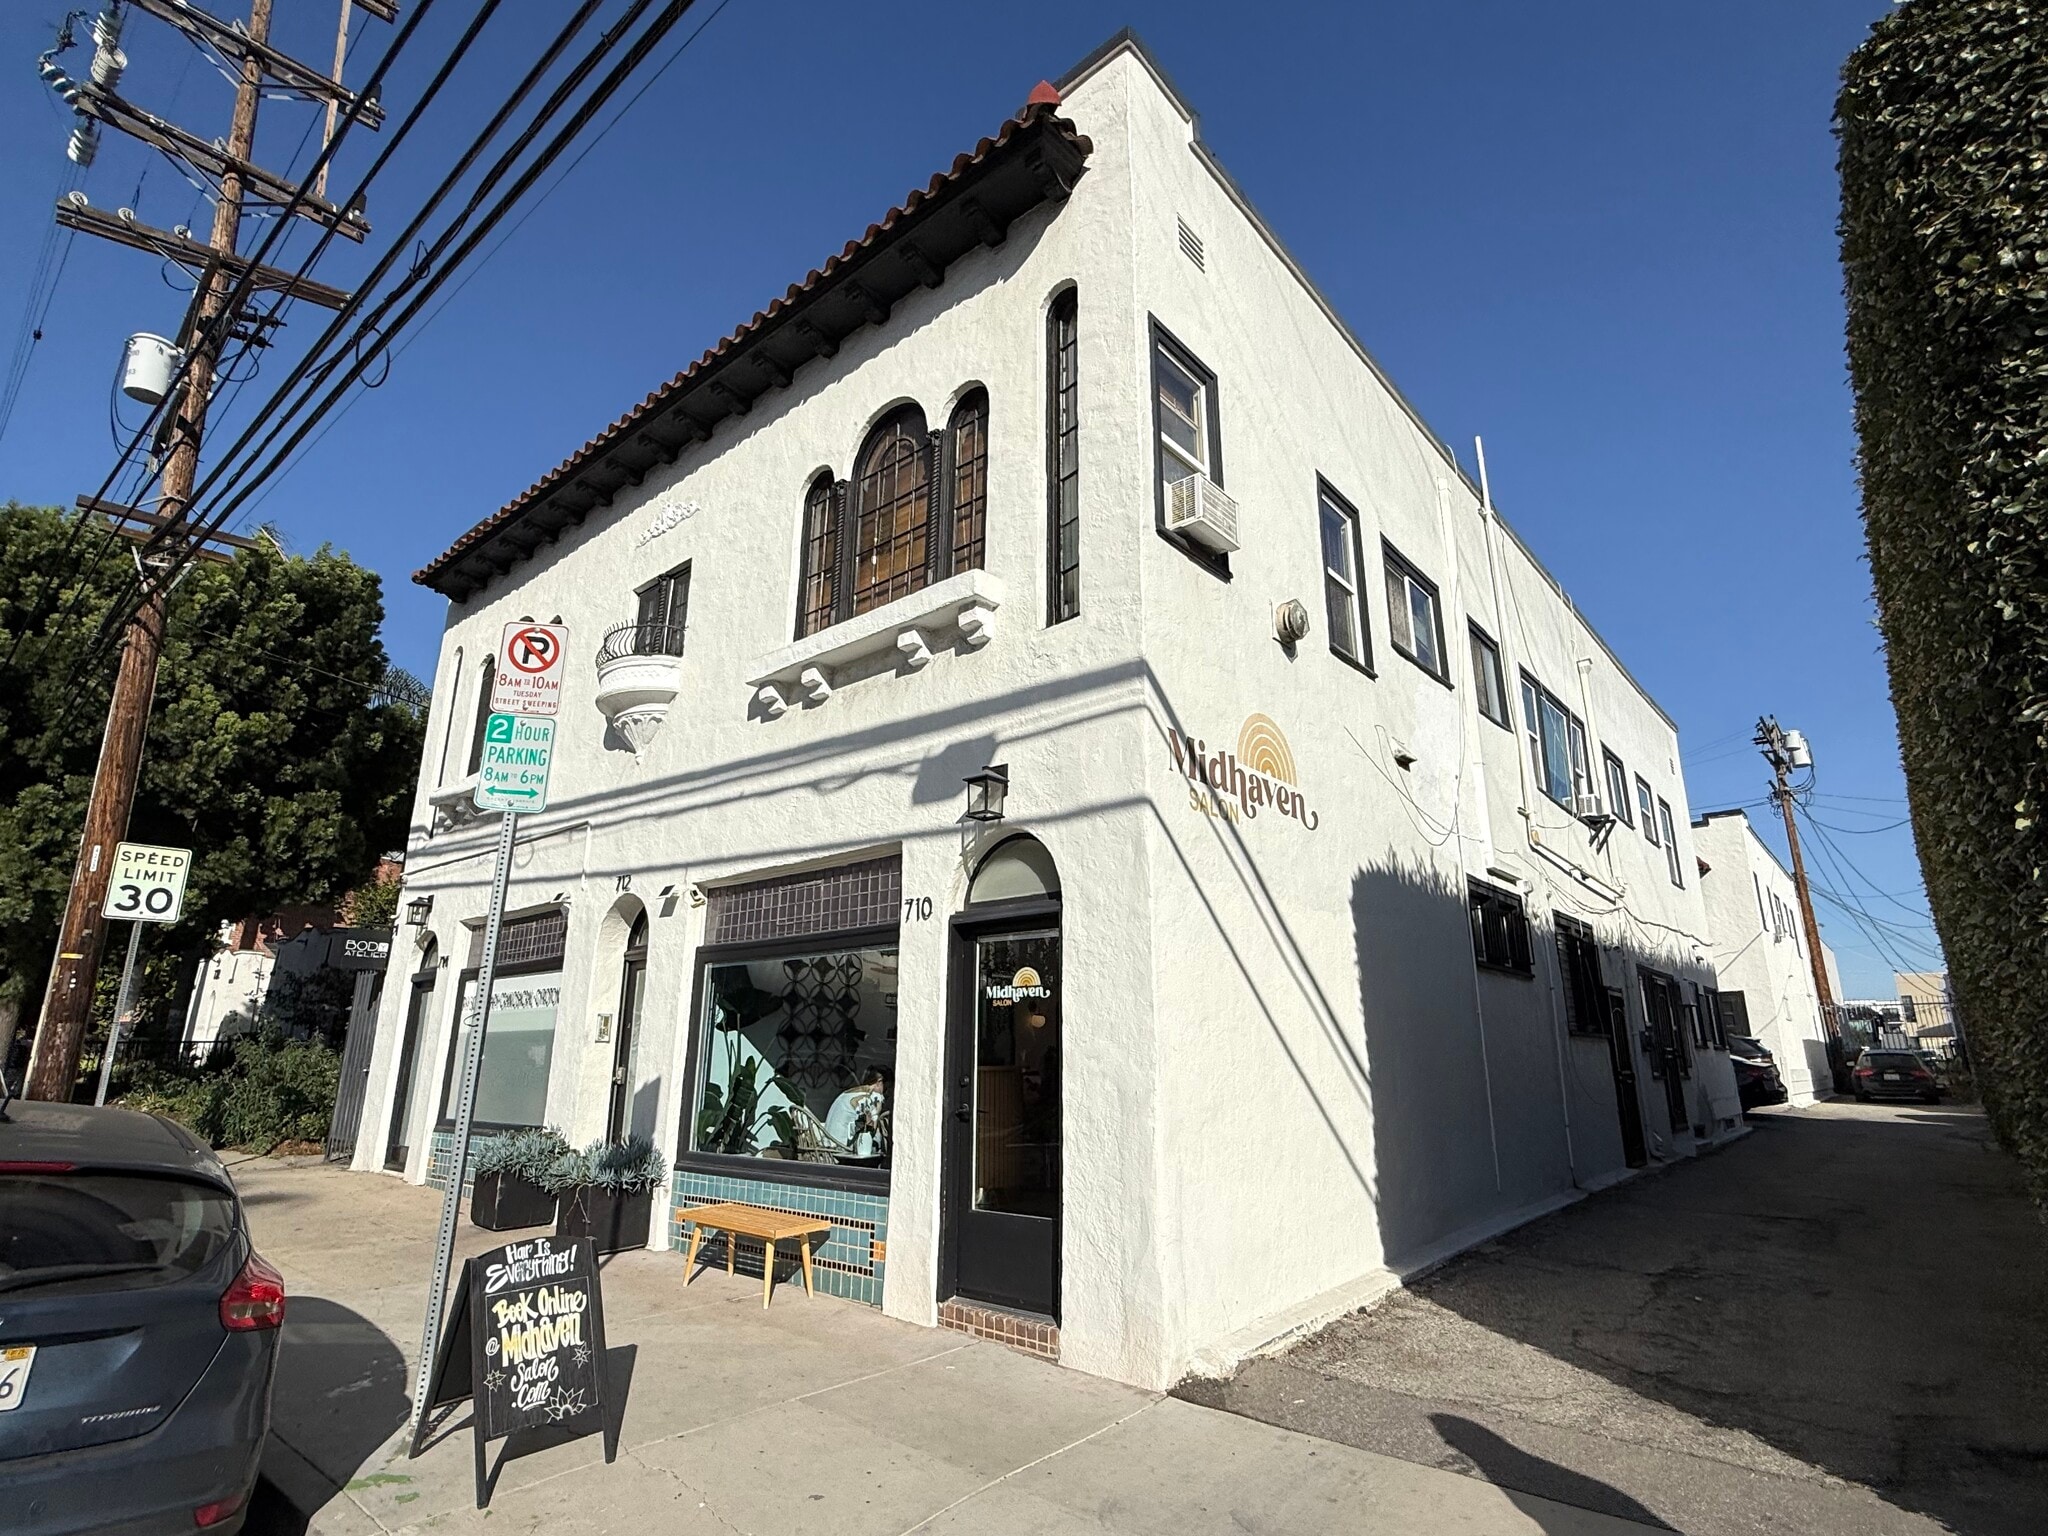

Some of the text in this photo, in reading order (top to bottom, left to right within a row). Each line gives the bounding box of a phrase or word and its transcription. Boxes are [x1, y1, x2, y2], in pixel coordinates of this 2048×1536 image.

[499, 673, 522, 688] 8AM
[532, 676, 559, 690] 10AM
[494, 697, 557, 709] STREET SWEEPING
[513, 690, 542, 698] TUESDAY
[491, 718, 550, 741] 2 HOUR
[487, 745, 548, 767] PARKING
[484, 766, 509, 782] 8AM
[520, 769, 545, 784] 6PM
[1167, 727, 1319, 831] Midhaven
[1189, 787, 1240, 825] SALON
[121, 851, 184, 867] SPEED
[124, 867, 177, 883] LIMIT
[114, 884, 173, 914] 30
[904, 896, 934, 923] 710
[344, 950, 387, 959] ATELIER
[345, 939, 389, 952] BODY
[986, 985, 1051, 1003] Midhaven
[992, 999, 1013, 1007] SALON
[533, 1238, 552, 1259] Is
[485, 1244, 578, 1293] Everything!
[537, 1285, 587, 1316] Online
[511, 1356, 559, 1392] Salon
